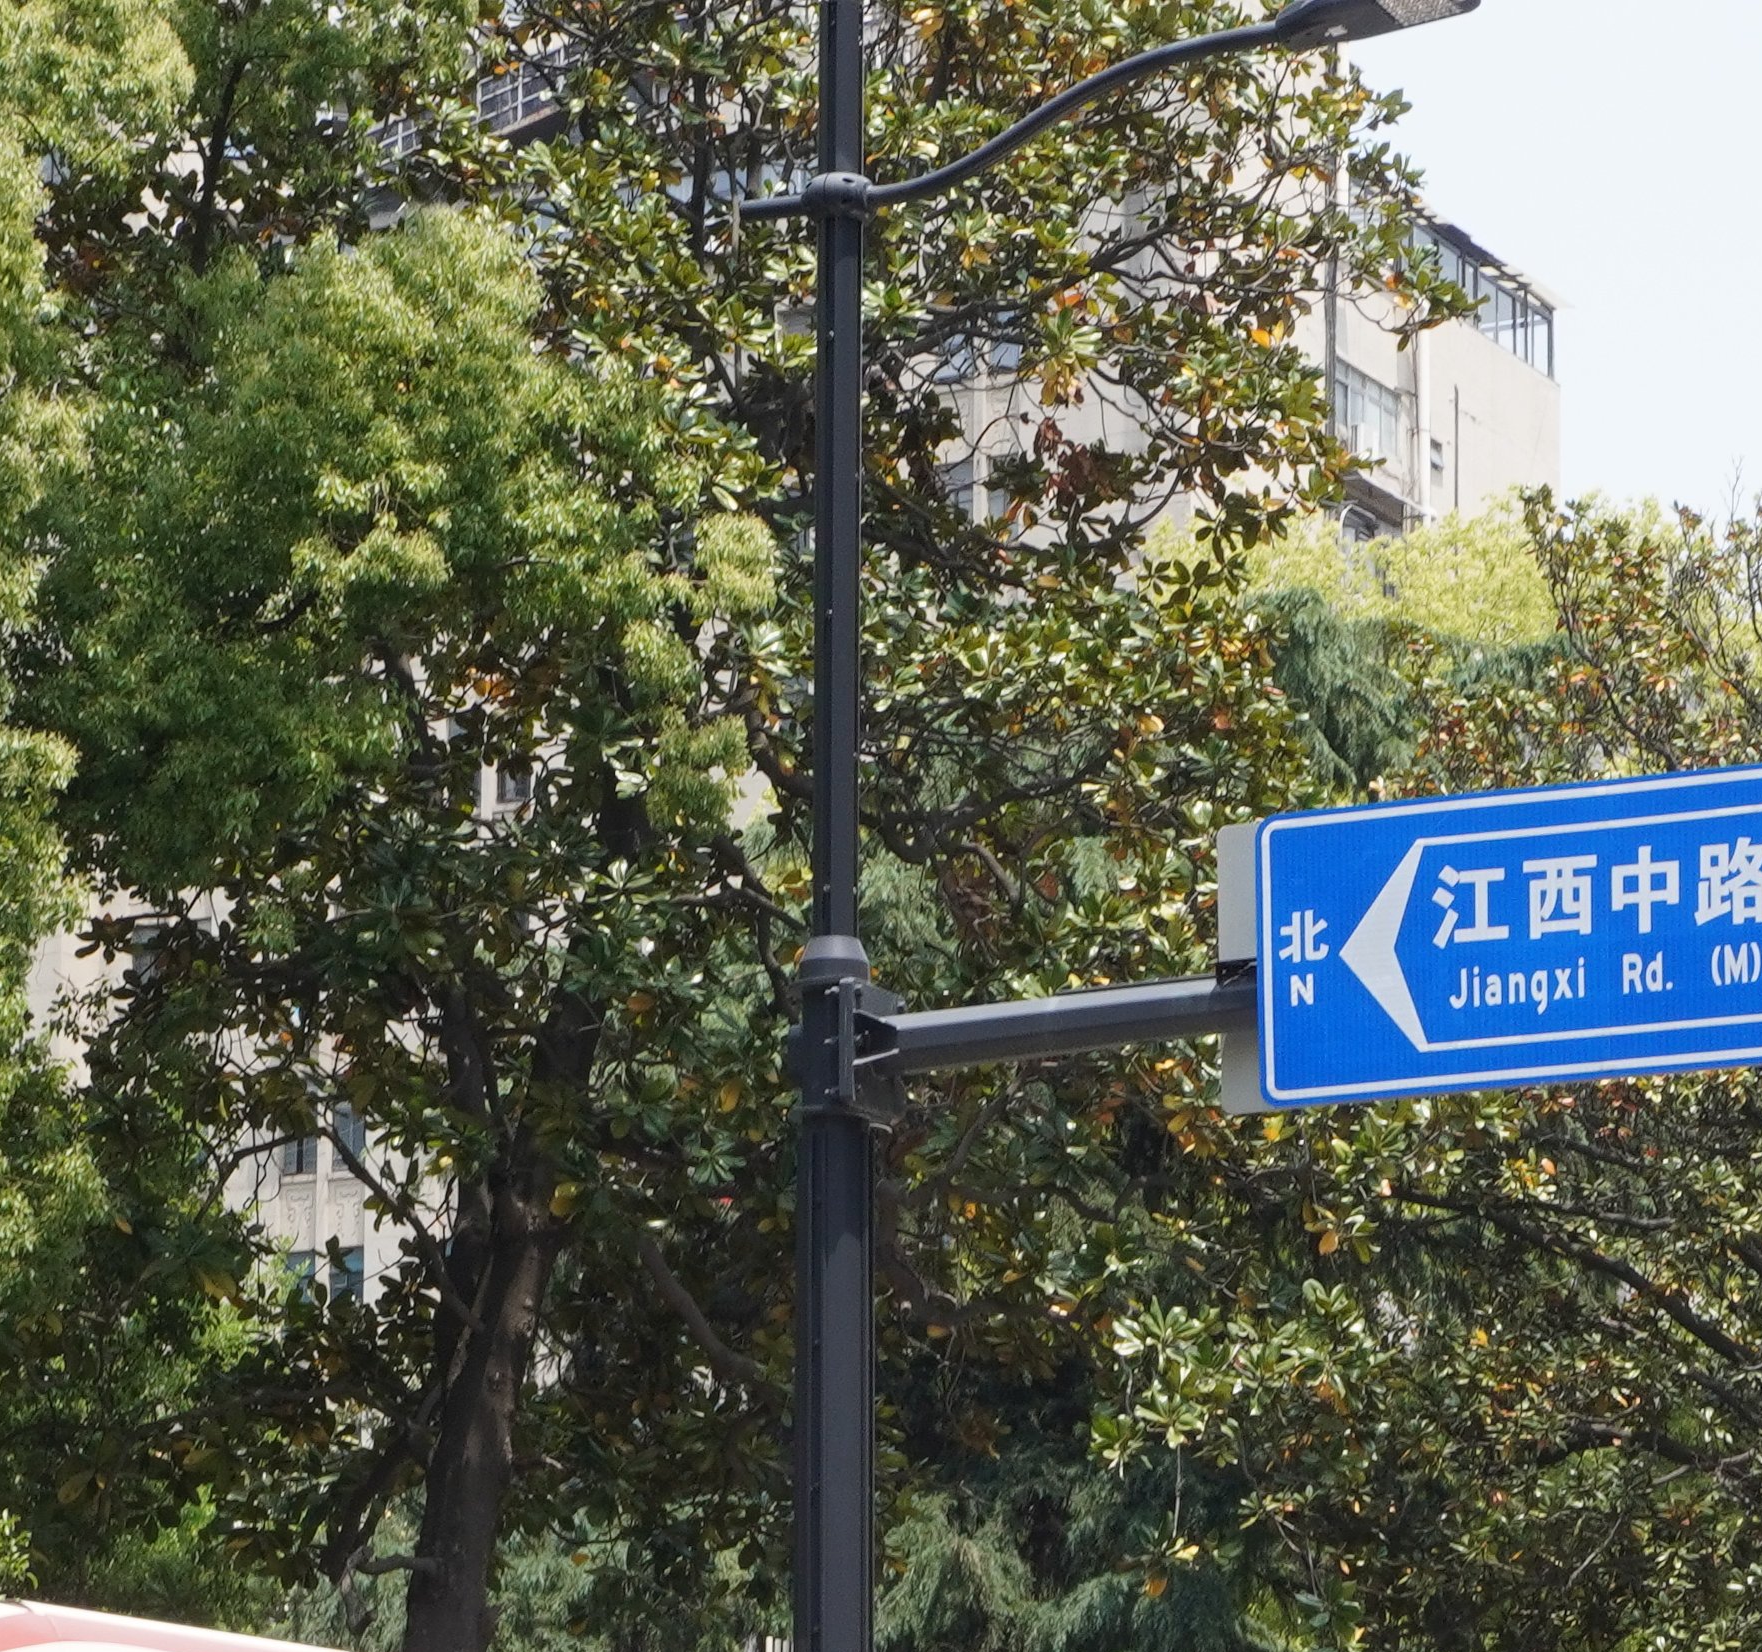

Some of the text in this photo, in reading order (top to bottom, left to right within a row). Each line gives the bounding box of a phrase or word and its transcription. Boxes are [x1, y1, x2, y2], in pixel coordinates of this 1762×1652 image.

[1278, 909, 1330, 964] 北
[1289, 972, 1315, 1007] N
[1449, 941, 1762, 1016] Jiangxi Rd. (M)
